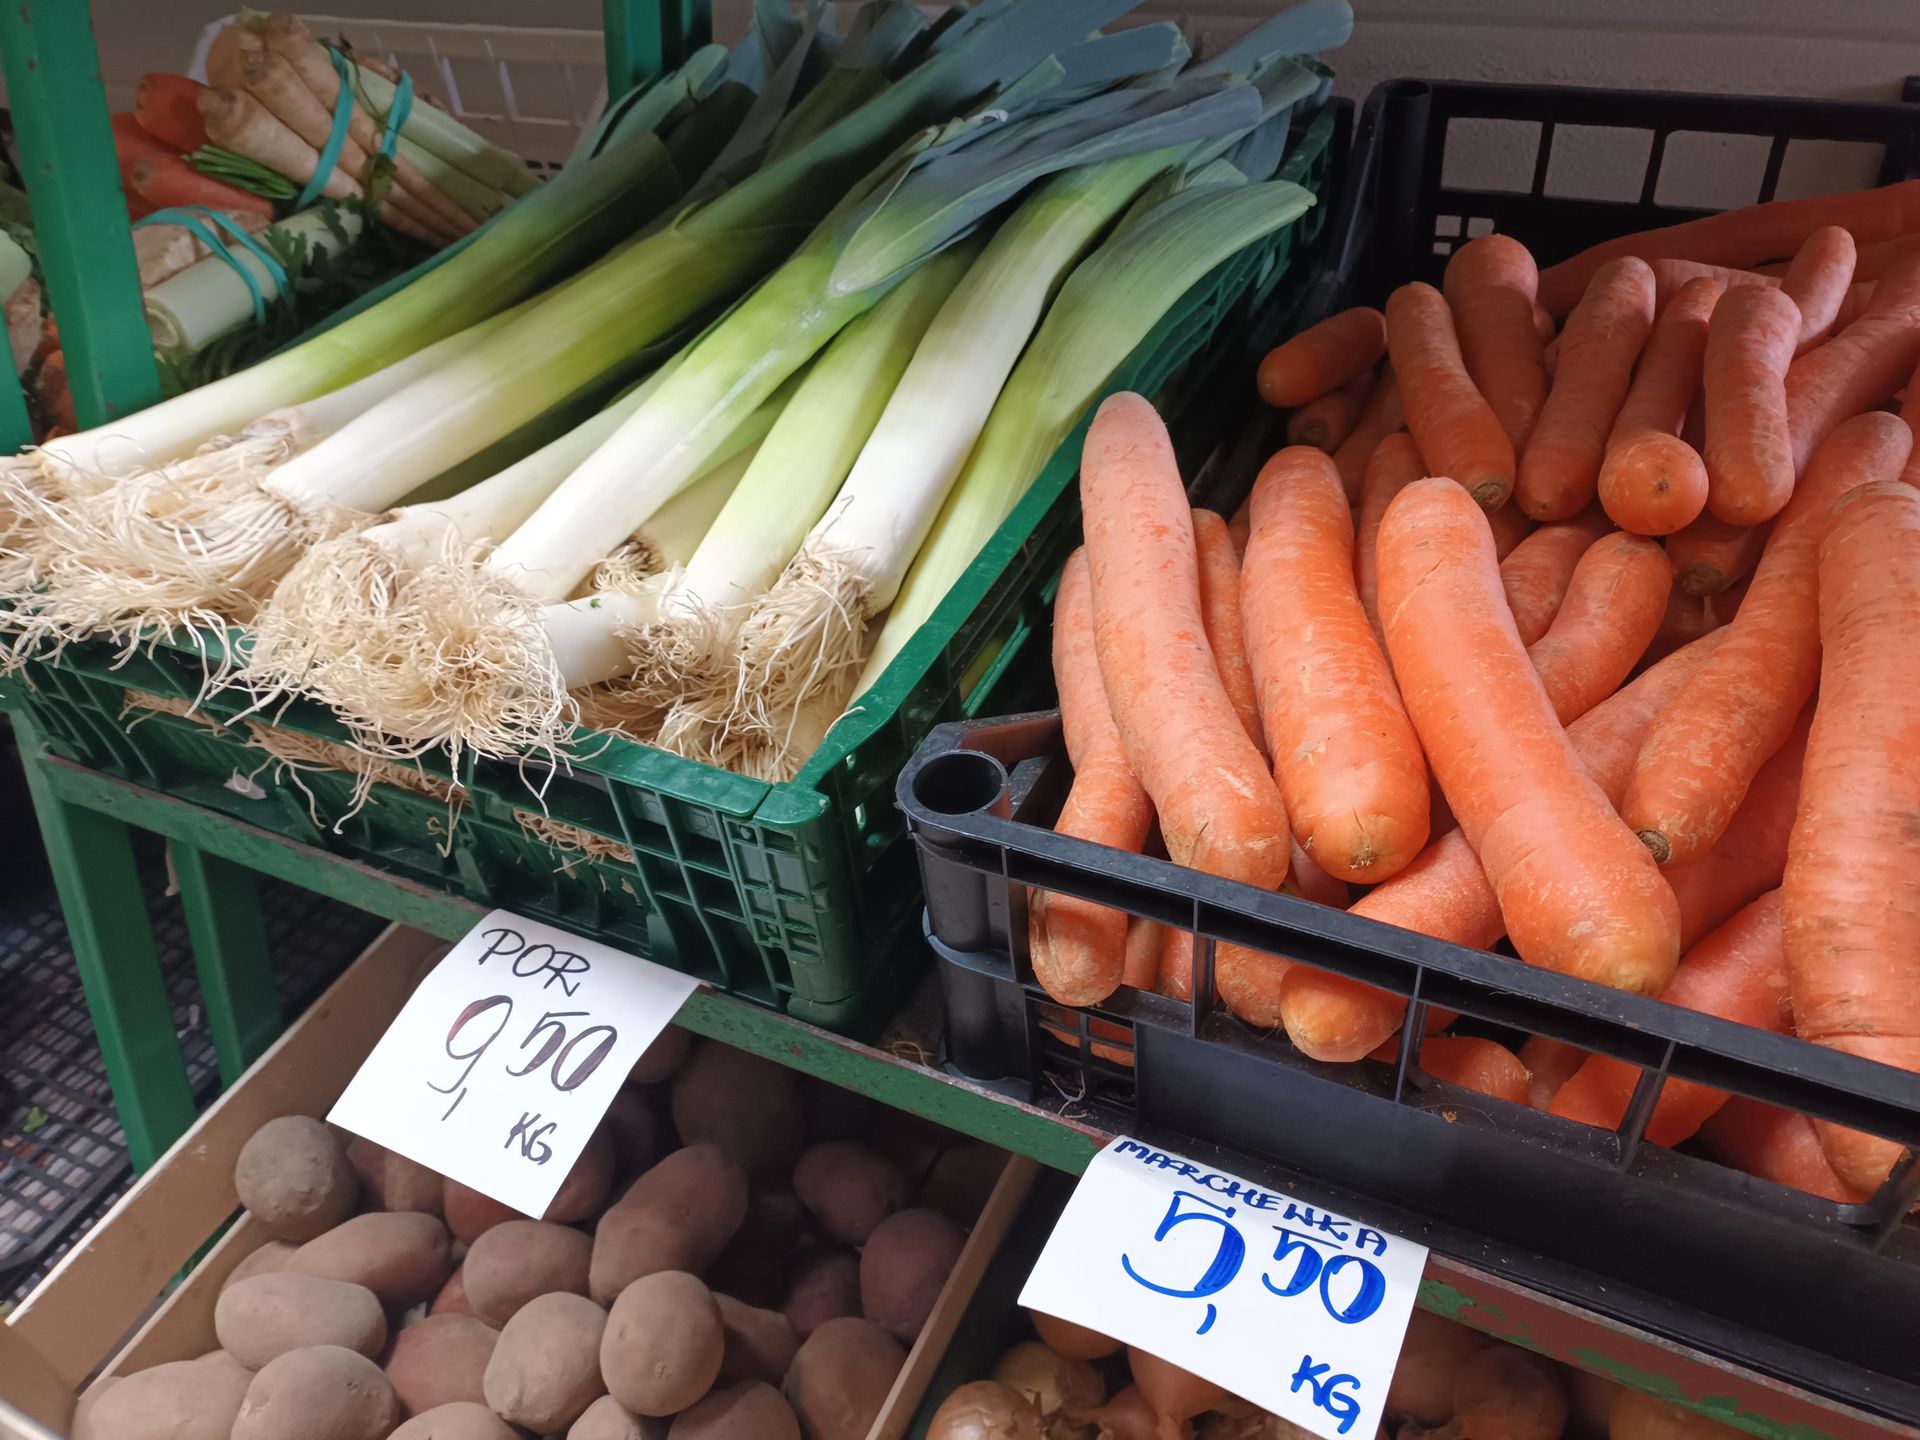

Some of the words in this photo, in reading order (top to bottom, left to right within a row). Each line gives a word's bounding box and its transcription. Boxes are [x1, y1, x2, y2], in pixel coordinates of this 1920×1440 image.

[479, 928, 590, 996] POR
[505, 1112, 557, 1165] KG
[1291, 1355, 1361, 1434] KG
